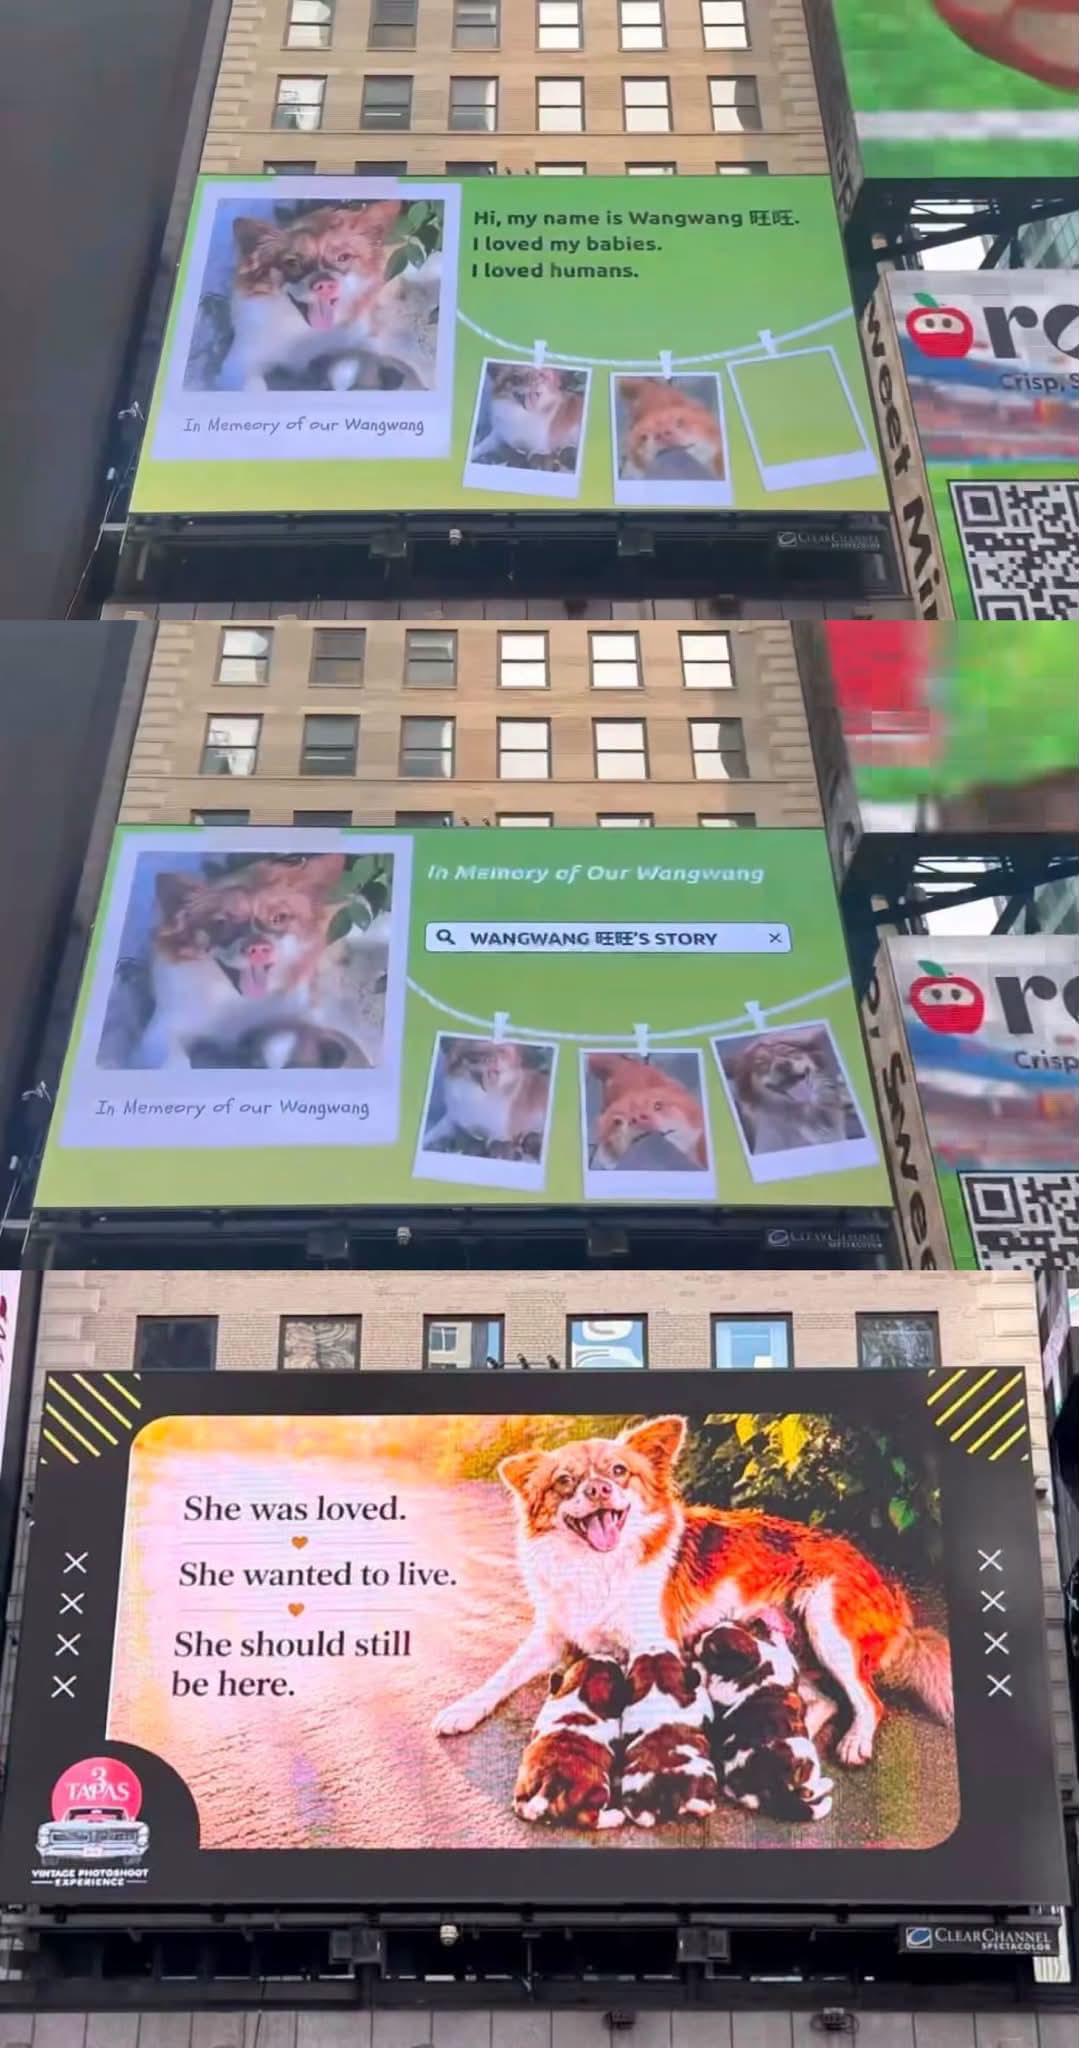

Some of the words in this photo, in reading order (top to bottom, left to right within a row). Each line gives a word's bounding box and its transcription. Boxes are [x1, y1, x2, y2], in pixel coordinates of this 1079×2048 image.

[474, 210, 501, 227] Hi,
[508, 213, 537, 228] my
[544, 213, 600, 225] name
[606, 210, 623, 225] is
[628, 211, 743, 229] Wangwang
[473, 237, 479, 251] I
[486, 236, 543, 251] loved
[551, 238, 580, 254] my
[586, 236, 662, 251] babies.
[472, 264, 478, 278] I
[485, 263, 544, 278] loved
[551, 263, 639, 278] humans.
[183, 418, 200, 433] In
[286, 416, 306, 431] of
[310, 421, 339, 431] our
[345, 418, 425, 436] Wangwang
[427, 865, 449, 881] In
[455, 865, 547, 883] Memory
[556, 864, 582, 884] of
[587, 866, 629, 881] Our
[636, 866, 765, 884] Wangwang
[470, 932, 590, 946] WANGWANG
[655, 932, 718, 946] STORY
[95, 1100, 115, 1116] In
[213, 1098, 235, 1114] of
[240, 1103, 272, 1115] our
[280, 1100, 370, 1120] Wangwang
[184, 1495, 241, 1521] She
[251, 1502, 308, 1521] was
[317, 1495, 406, 1521] loved.
[179, 1561, 235, 1586] She
[242, 1561, 351, 1586] wanted
[361, 1565, 389, 1586] to
[398, 1561, 457, 1586] live.
[174, 1630, 232, 1657] She
[240, 1630, 345, 1657] should
[354, 1630, 411, 1657] still
[172, 1670, 208, 1697] be
[217, 1670, 295, 1697] here.
[66, 1782, 130, 1801] TAPAS
[31, 1869, 76, 1878] VINTAGE
[78, 1868, 149, 1878] PHOTOSHOOT
[54, 1878, 124, 1887] EXPERIENCE
[981, 1942, 1051, 1951] SPECTACOLOR
